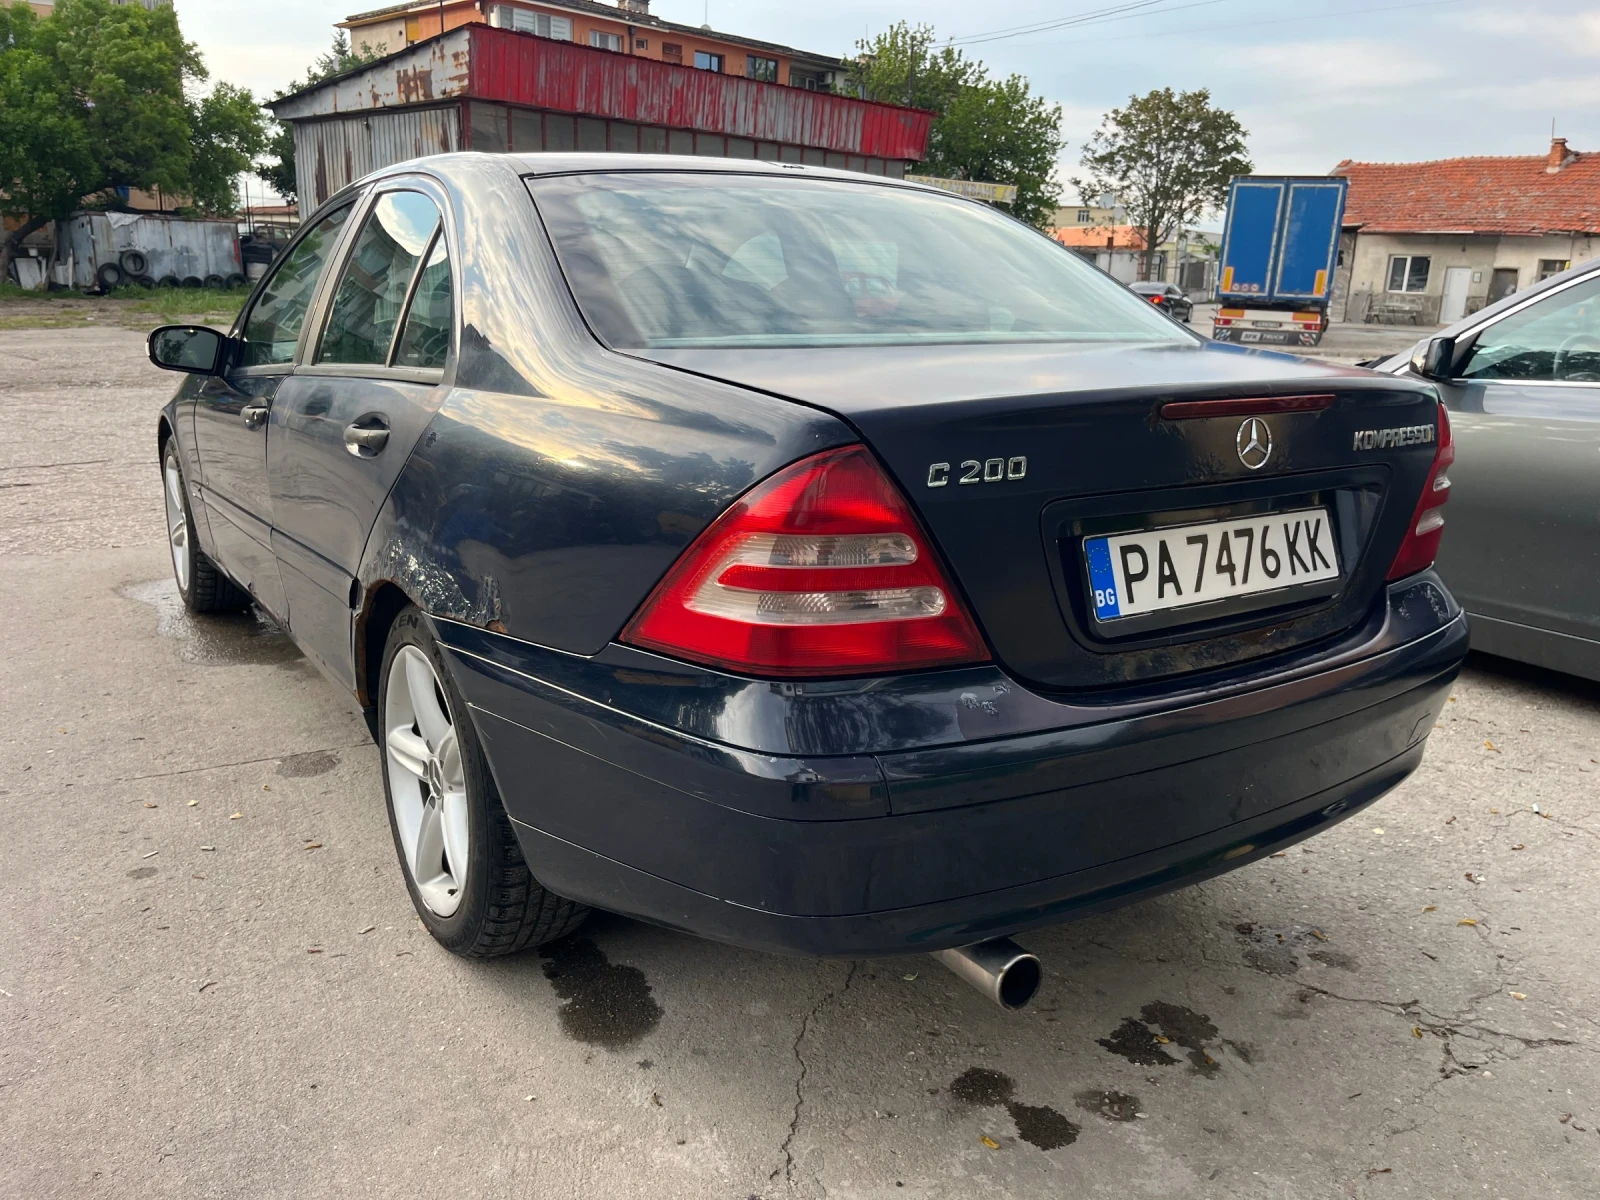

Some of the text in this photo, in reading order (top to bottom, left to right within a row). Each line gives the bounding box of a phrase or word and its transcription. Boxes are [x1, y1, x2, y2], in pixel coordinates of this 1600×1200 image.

[1262, 333, 1285, 341] TRUCK
[1353, 424, 1434, 451] KOMPRESSOR
[928, 456, 1027, 487] C 200
[1095, 588, 1116, 607] BG
